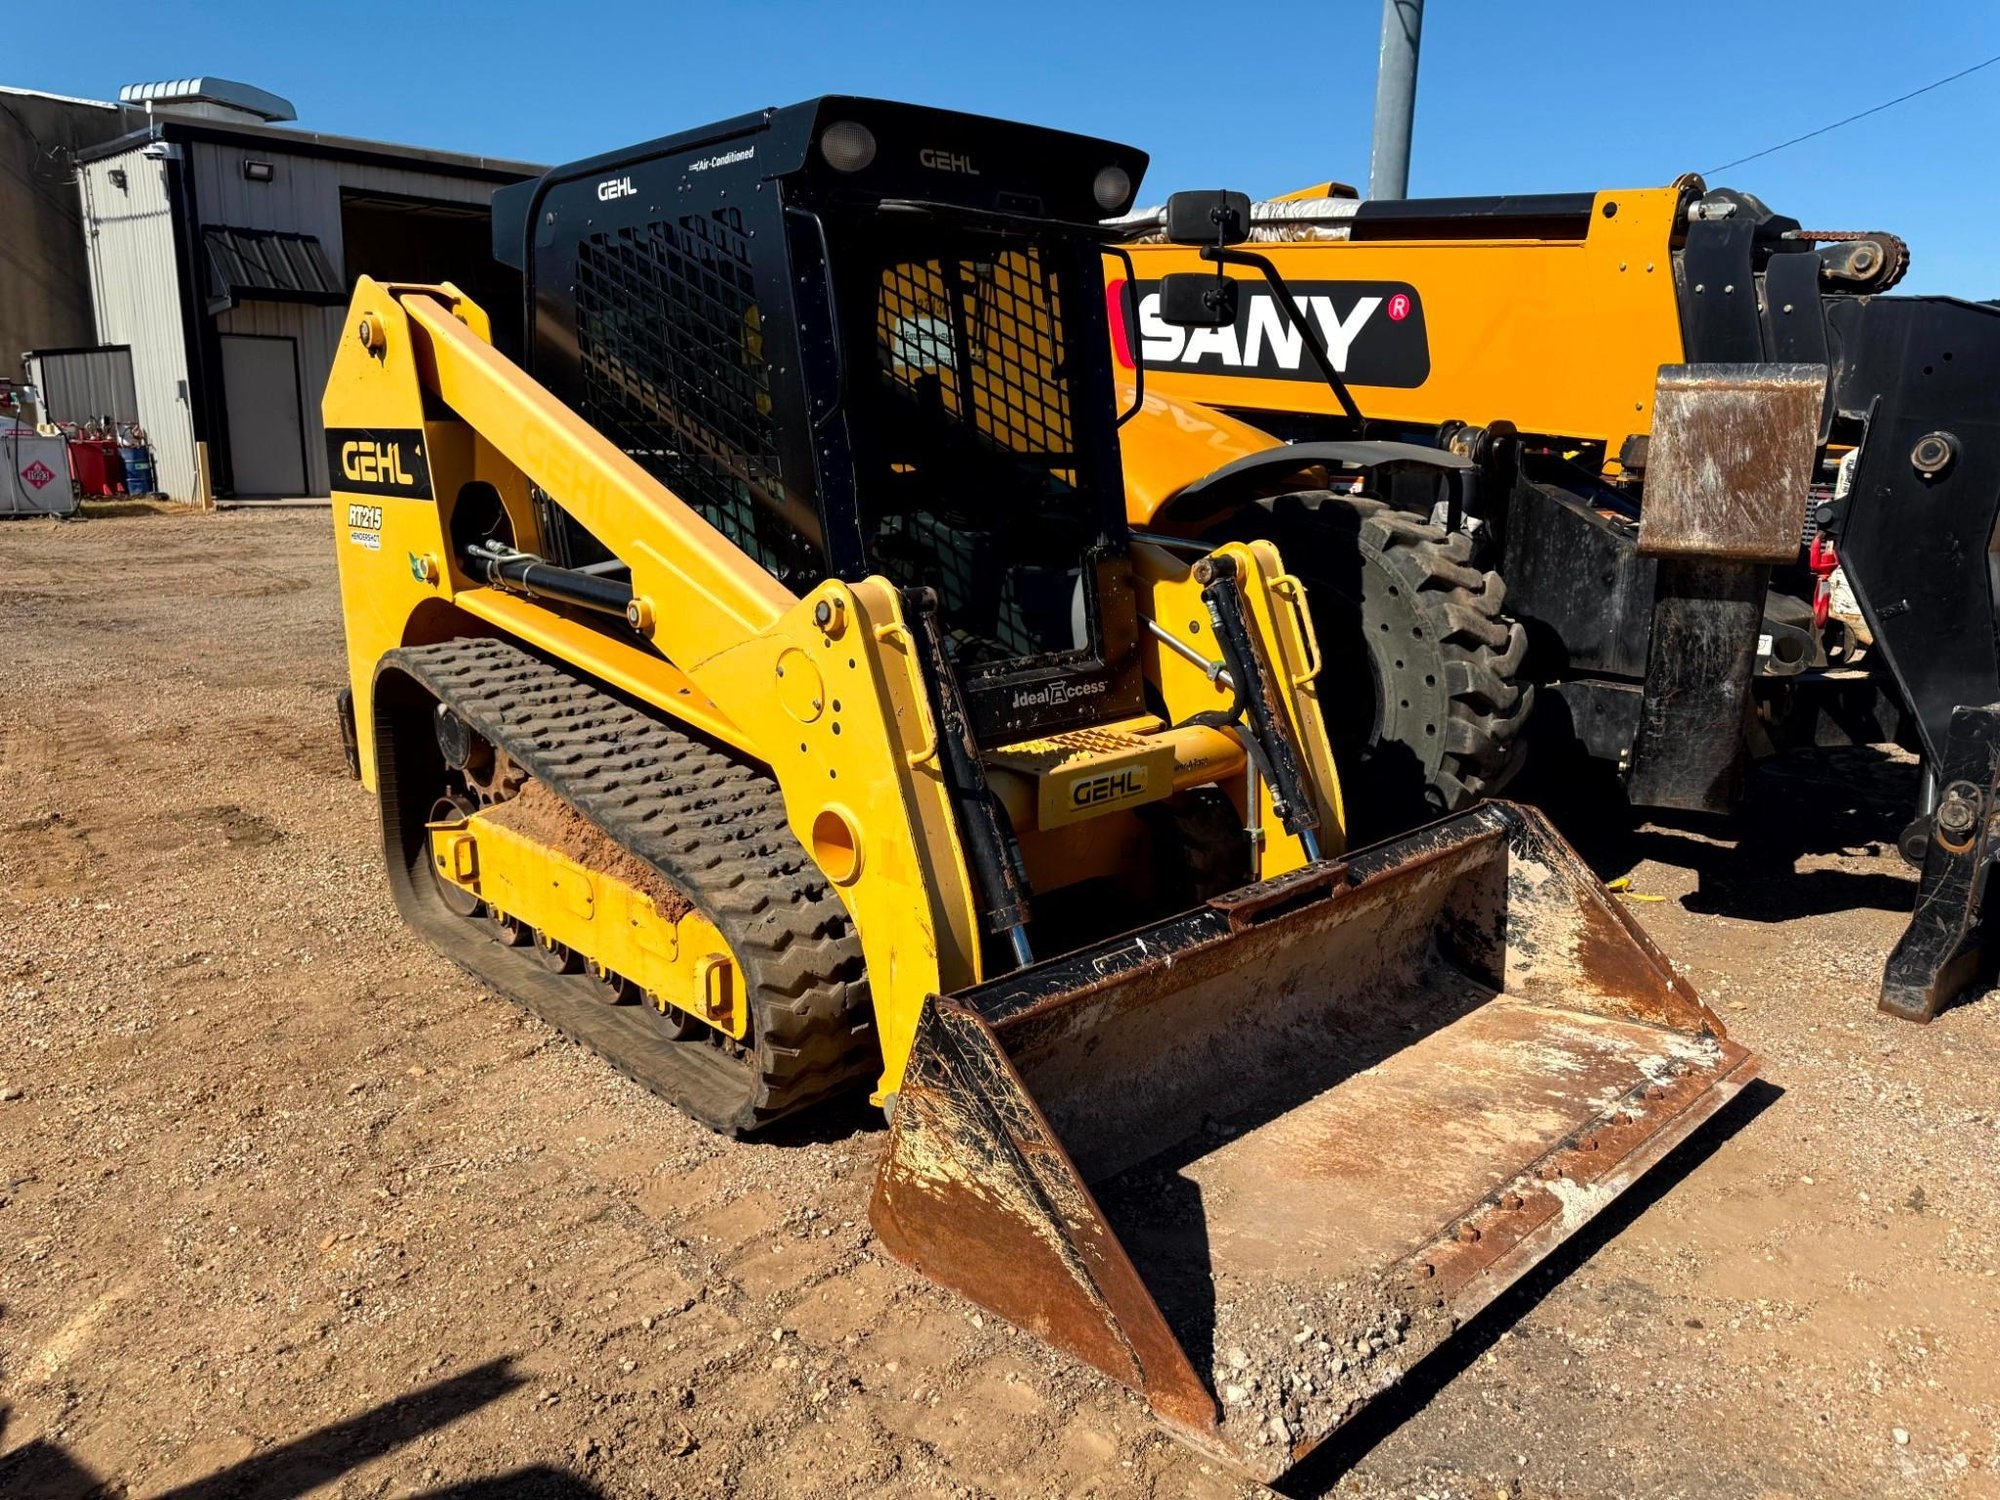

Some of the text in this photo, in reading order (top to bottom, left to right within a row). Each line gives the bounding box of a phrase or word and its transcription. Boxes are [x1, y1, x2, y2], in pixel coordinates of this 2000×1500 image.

[698, 146, 754, 171] Air-Conditioned
[920, 148, 980, 176] GEHL
[597, 176, 638, 202] GEHL
[1138, 293, 1383, 373] SANY
[342, 441, 414, 485] GEHL
[348, 503, 382, 530] RT215
[1073, 770, 1142, 806] GEHL
